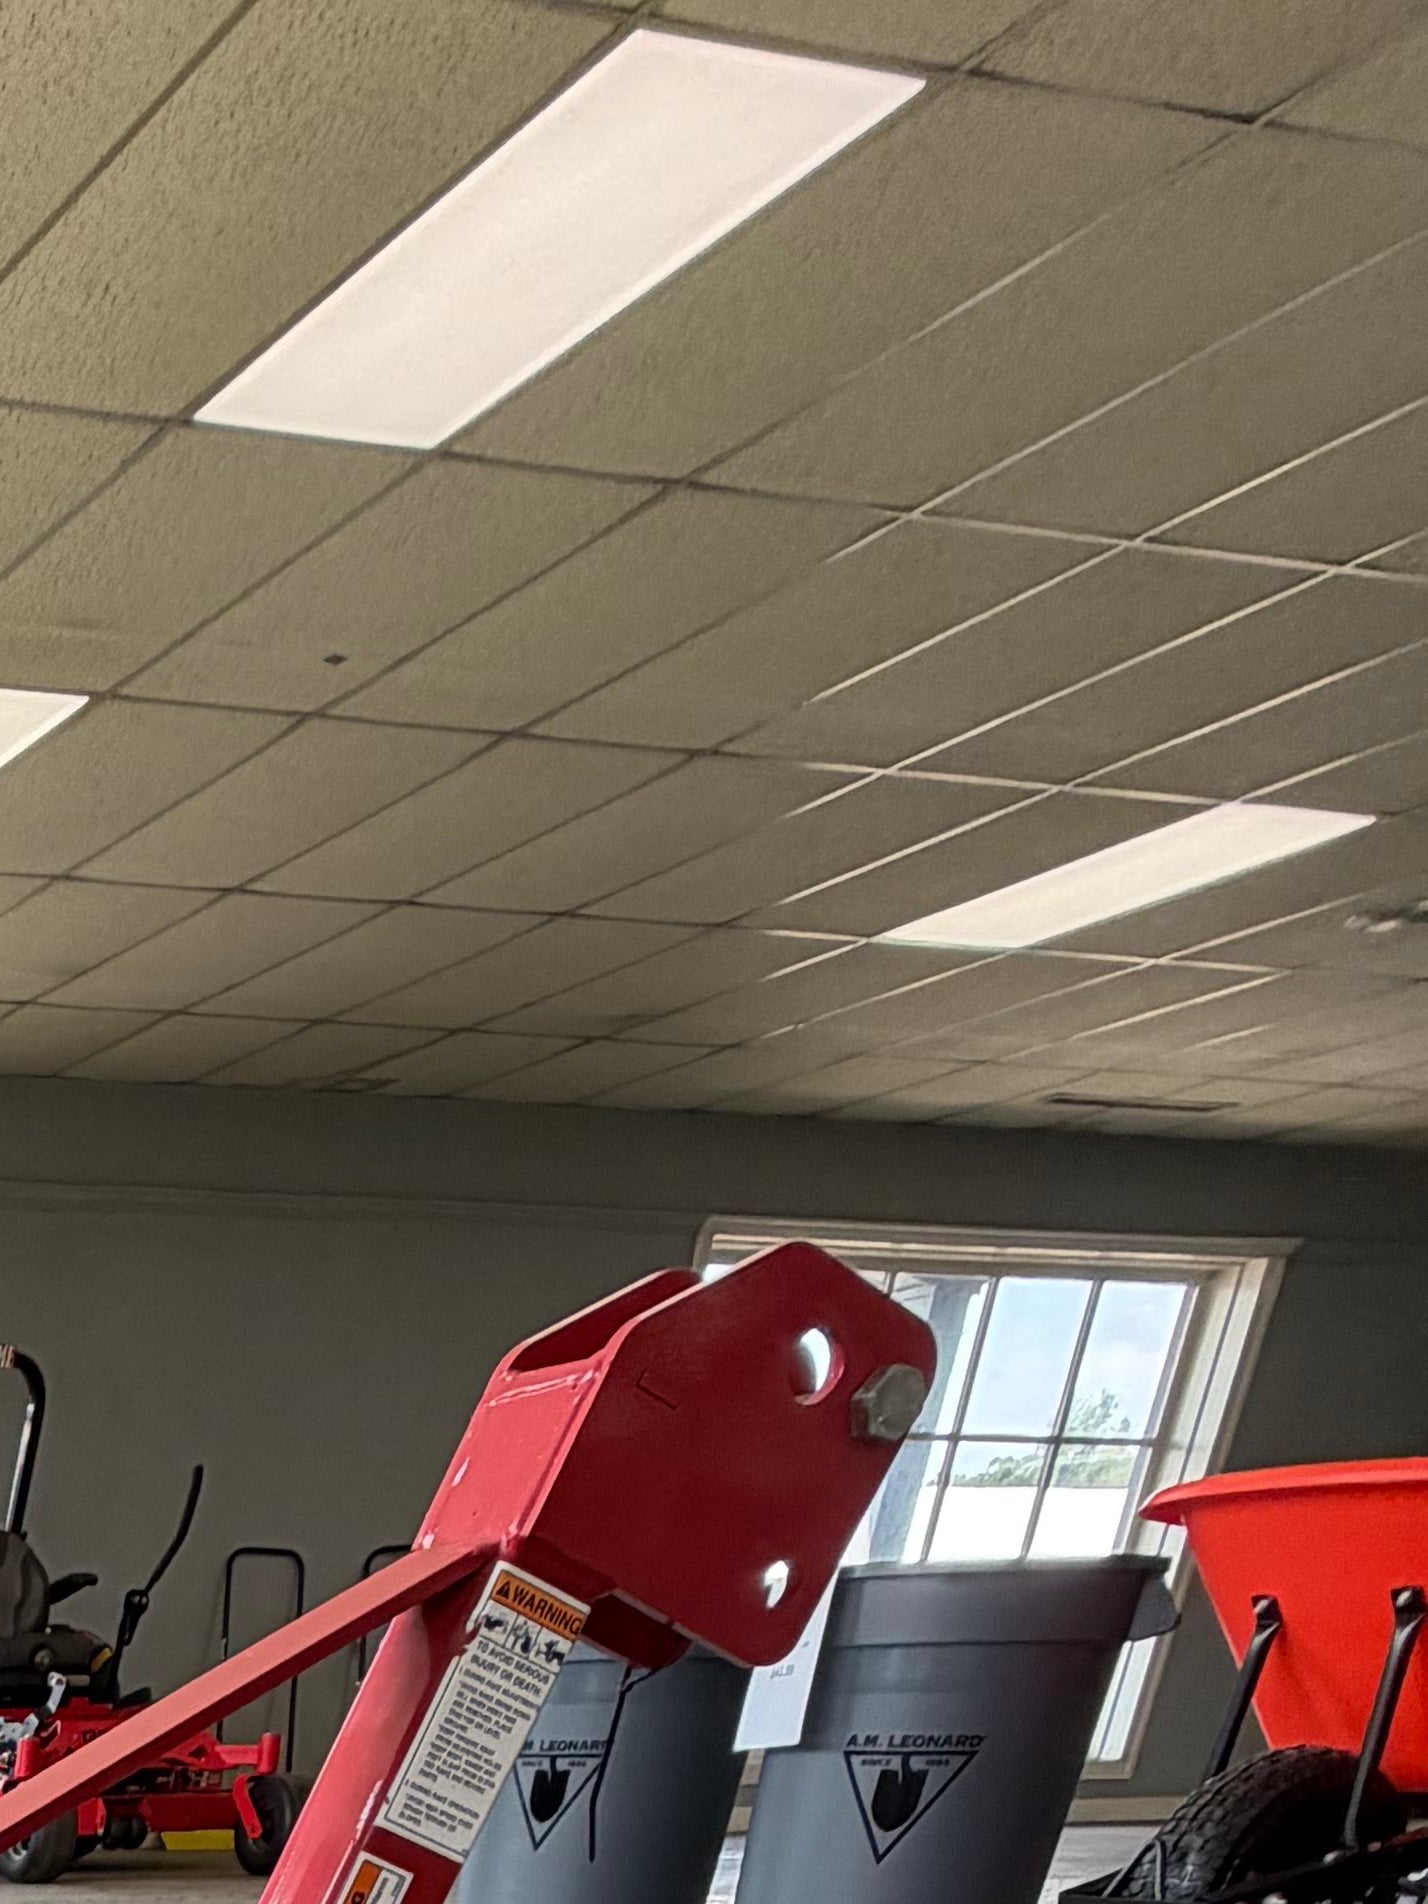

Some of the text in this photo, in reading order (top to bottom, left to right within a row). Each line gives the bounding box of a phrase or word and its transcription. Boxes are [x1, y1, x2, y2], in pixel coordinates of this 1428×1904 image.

[512, 1584, 583, 1634] WARNING
[846, 1734, 985, 1748] A.M. LEONARD
